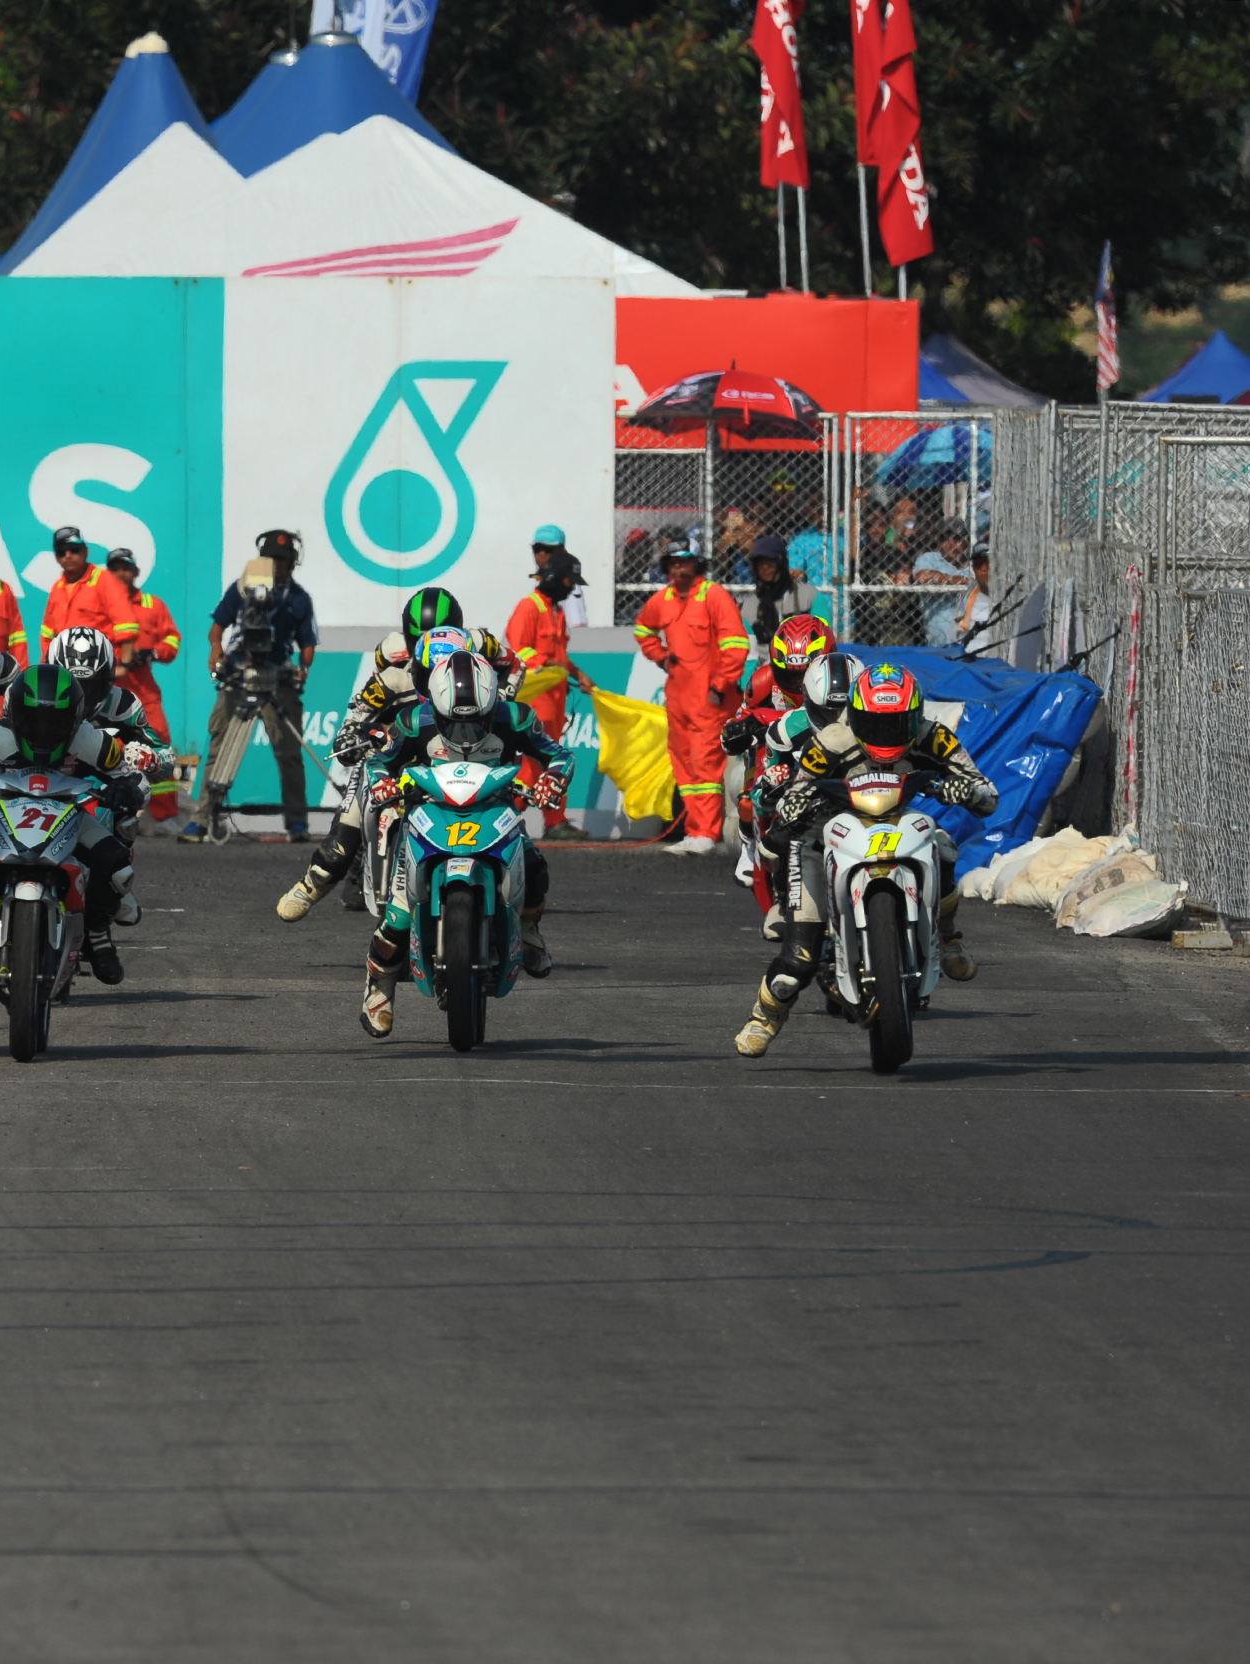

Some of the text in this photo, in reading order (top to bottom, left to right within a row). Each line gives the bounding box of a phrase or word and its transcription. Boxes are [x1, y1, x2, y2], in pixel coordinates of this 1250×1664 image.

[848, 772, 900, 787] YAMALUBE
[15, 808, 58, 832] 21
[445, 821, 481, 847] 12
[865, 832, 902, 858] 11
[788, 840, 801, 909] YAMALUBE
